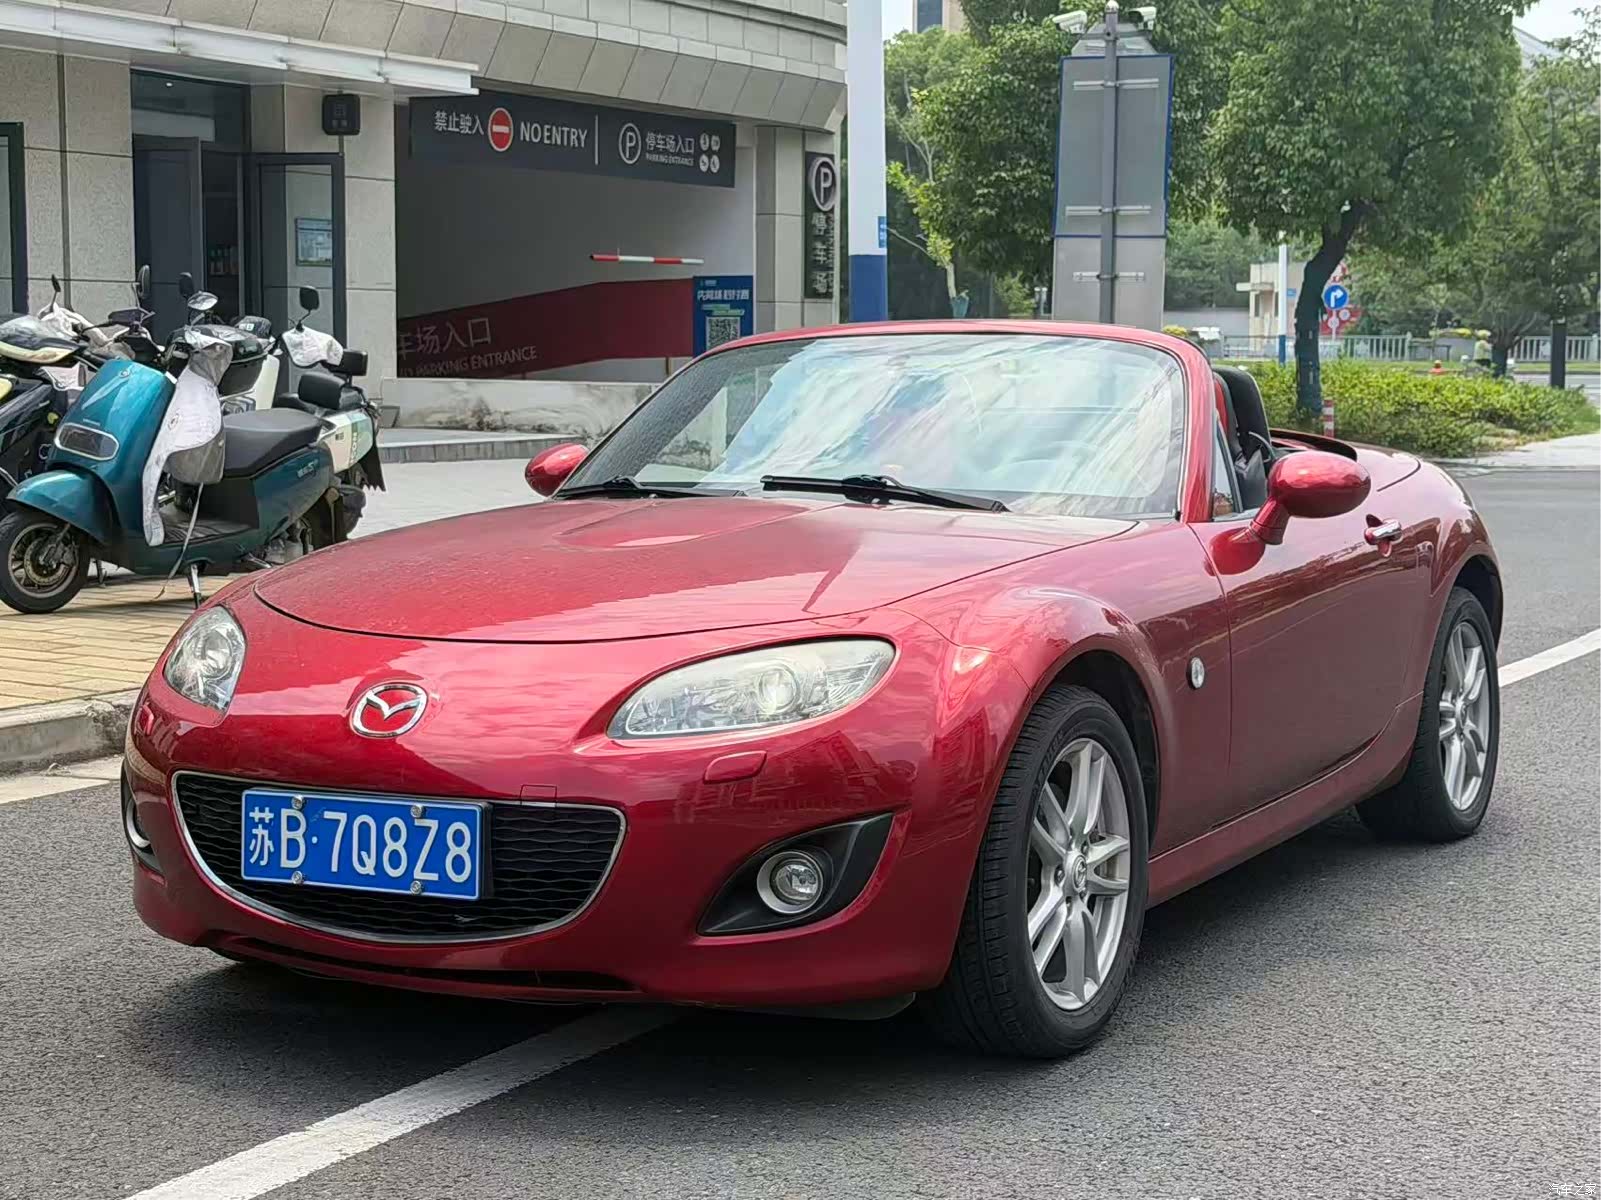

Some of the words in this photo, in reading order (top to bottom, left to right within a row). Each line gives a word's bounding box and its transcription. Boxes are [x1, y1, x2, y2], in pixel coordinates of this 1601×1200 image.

[435, 110, 484, 135] 禁止驶入
[520, 121, 541, 143] NO
[543, 125, 588, 148] ENTRY
[646, 131, 695, 154] 停车场入口
[416, 358, 469, 376] PARKING
[471, 346, 537, 370] ENTRANCE
